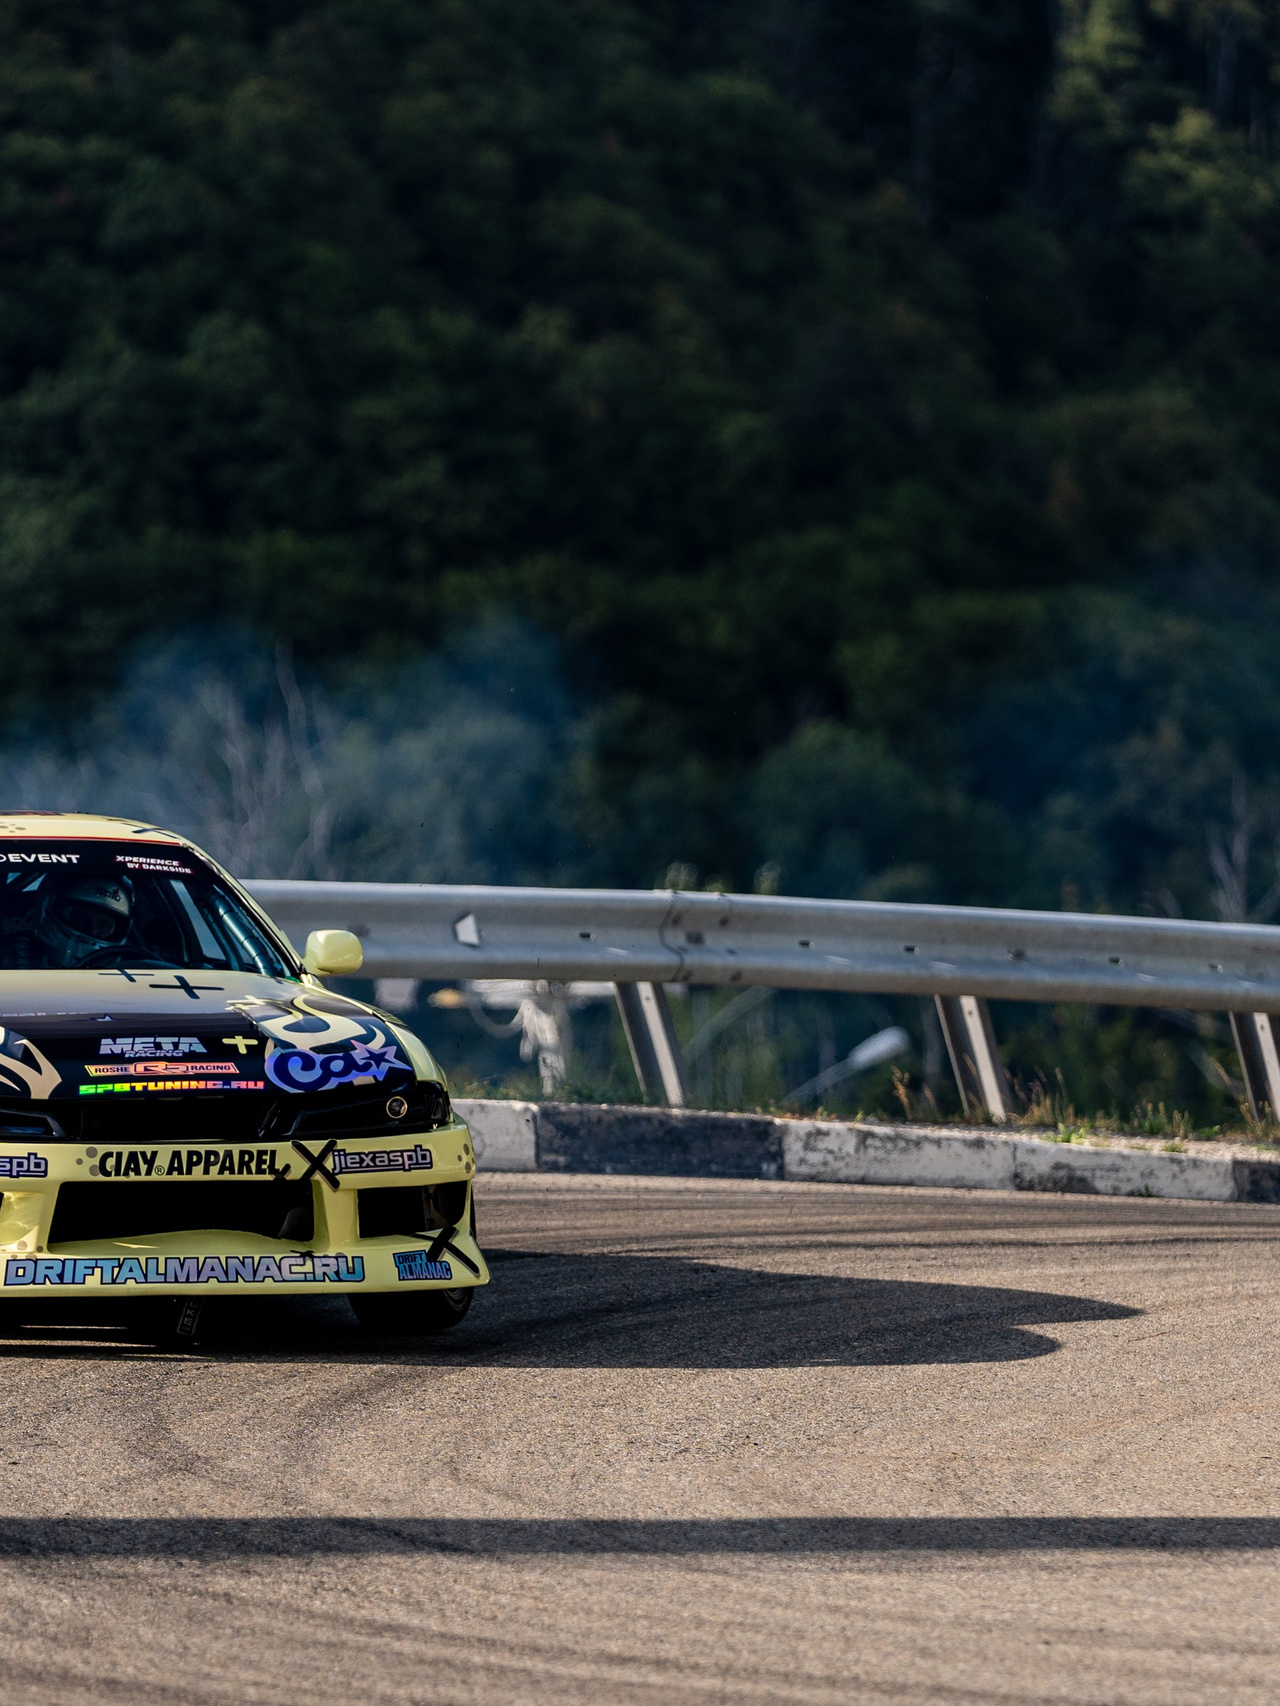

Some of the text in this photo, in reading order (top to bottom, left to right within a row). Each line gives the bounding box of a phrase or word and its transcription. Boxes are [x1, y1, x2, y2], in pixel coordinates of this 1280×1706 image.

[115, 854, 180, 867] XPERIENCE
[141, 863, 193, 874] DARKSIDE
[99, 1037, 208, 1055] META
[124, 1050, 184, 1058] RACING
[94, 1066, 131, 1074] ROSHE
[190, 1064, 232, 1072] RACING
[78, 1080, 265, 1096] SPBTUNING.RU
[166, 1149, 280, 1176] APPAREL
[333, 1147, 431, 1174] jiexaspb
[397, 1252, 424, 1263] DRIFT
[4, 1256, 365, 1286] DRIFTALMANAC.RU
[399, 1262, 452, 1280] ALMANAC
